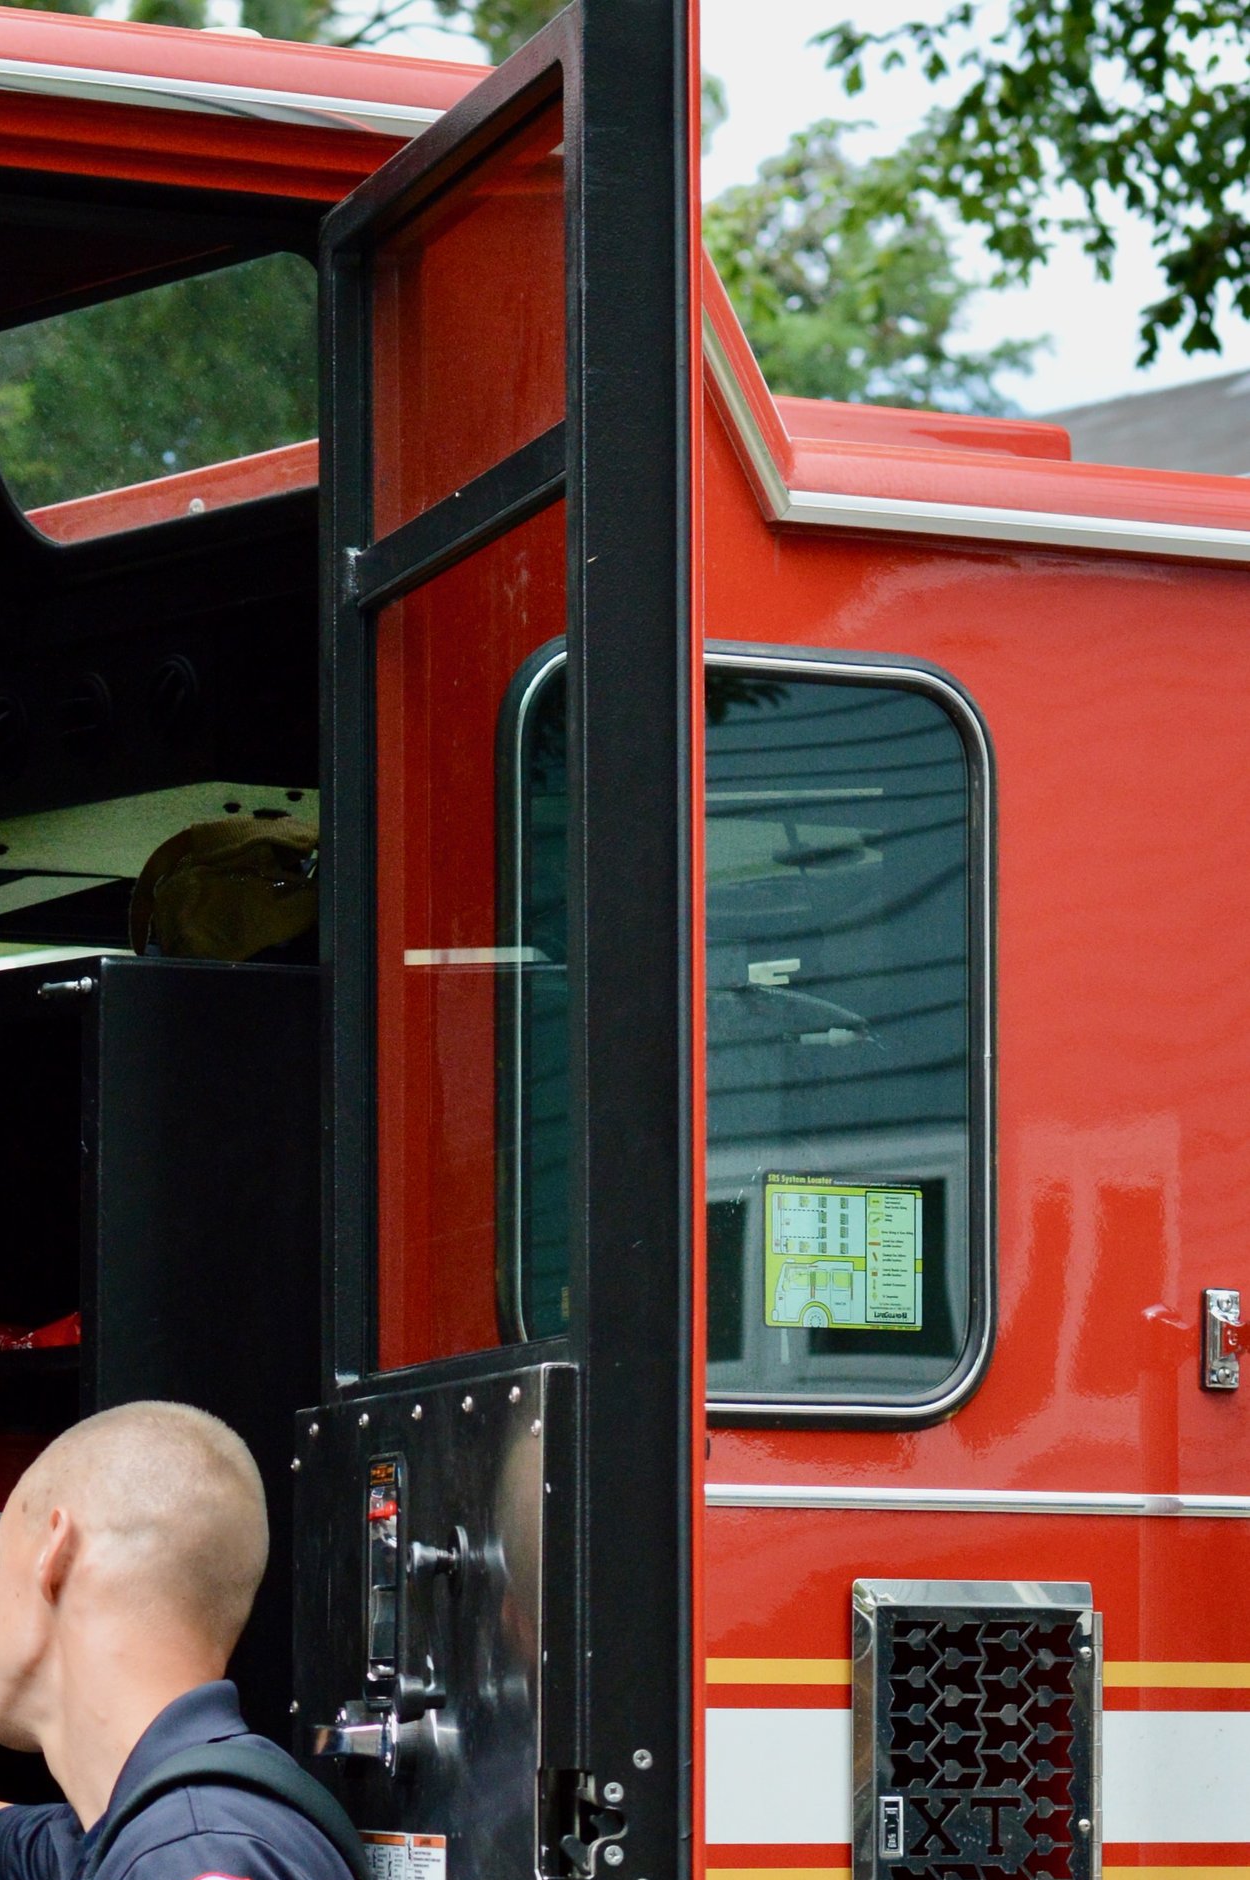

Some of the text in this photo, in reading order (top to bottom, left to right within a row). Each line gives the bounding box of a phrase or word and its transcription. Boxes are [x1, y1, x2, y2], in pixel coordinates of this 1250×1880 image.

[767, 1173, 832, 1185] SRS System Locator
[908, 1795, 1022, 1857] XT
